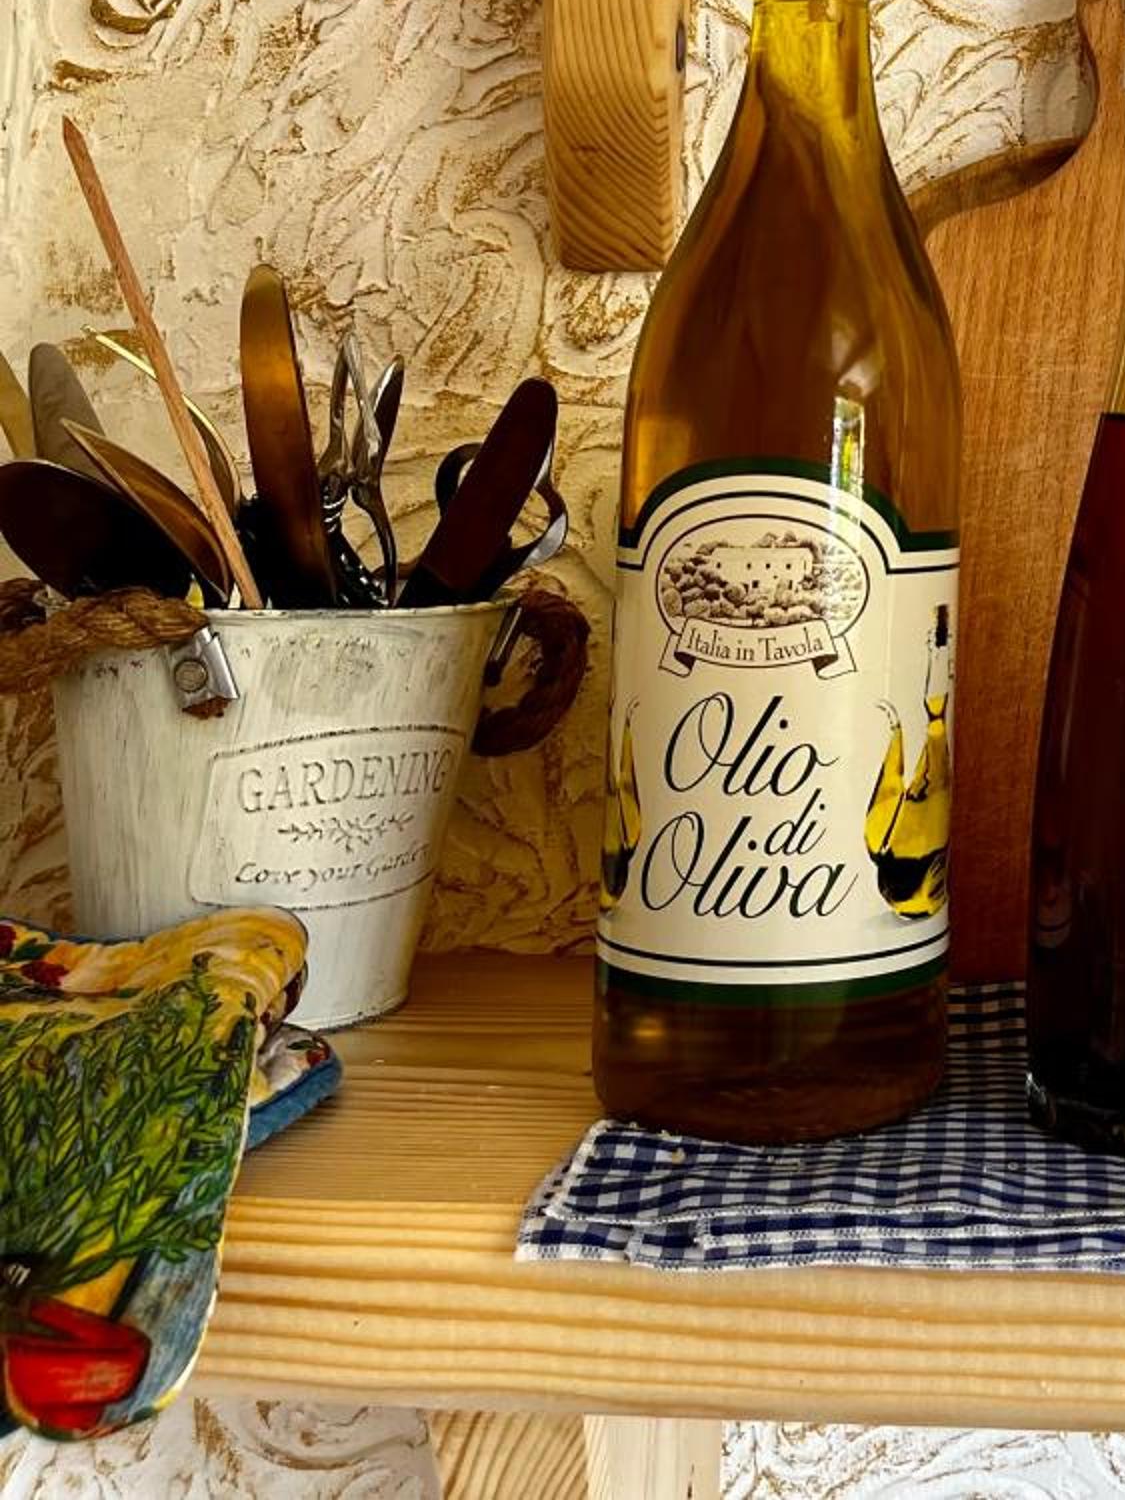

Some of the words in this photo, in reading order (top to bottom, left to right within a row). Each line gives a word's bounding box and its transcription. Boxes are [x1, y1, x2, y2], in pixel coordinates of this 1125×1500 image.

[686, 628, 730, 659] Italia
[736, 639, 755, 661] in
[757, 626, 823, 661] Tavola
[664, 692, 839, 797] Olio
[239, 749, 451, 813] GARDENING
[764, 788, 827, 855] di
[641, 811, 859, 918] Oliva
